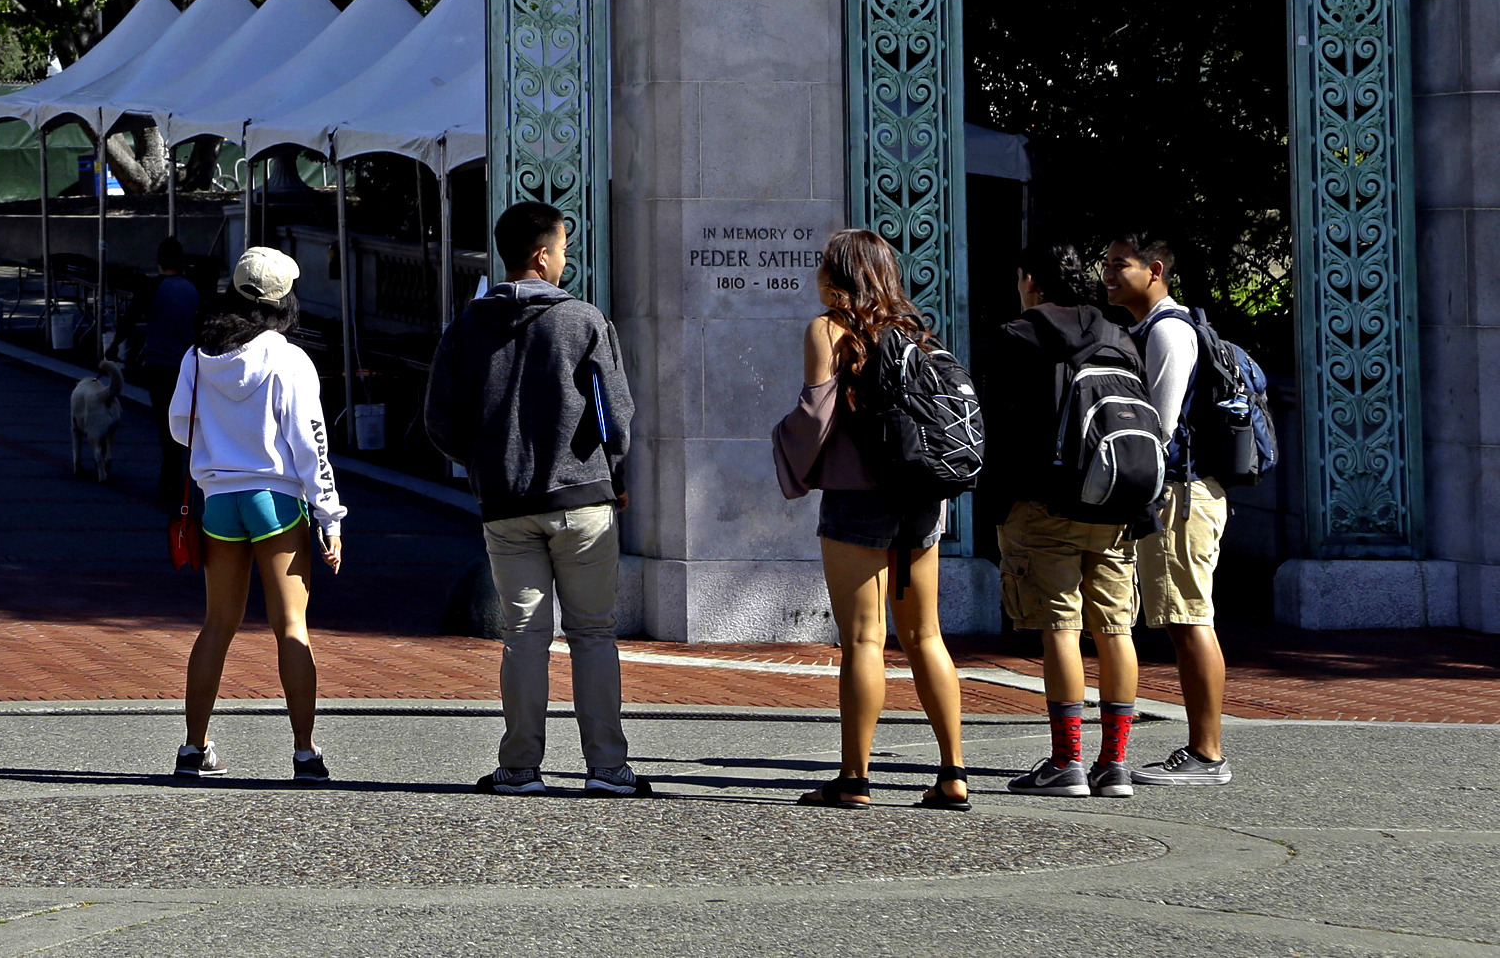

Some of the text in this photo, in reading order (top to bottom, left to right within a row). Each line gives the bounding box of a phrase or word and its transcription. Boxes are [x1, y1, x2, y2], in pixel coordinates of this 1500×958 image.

[703, 227, 814, 241] IN MEMORY OF
[690, 250, 824, 268] PEDER SATHER
[717, 276, 746, 290] 1810
[766, 277, 800, 291] 1886
